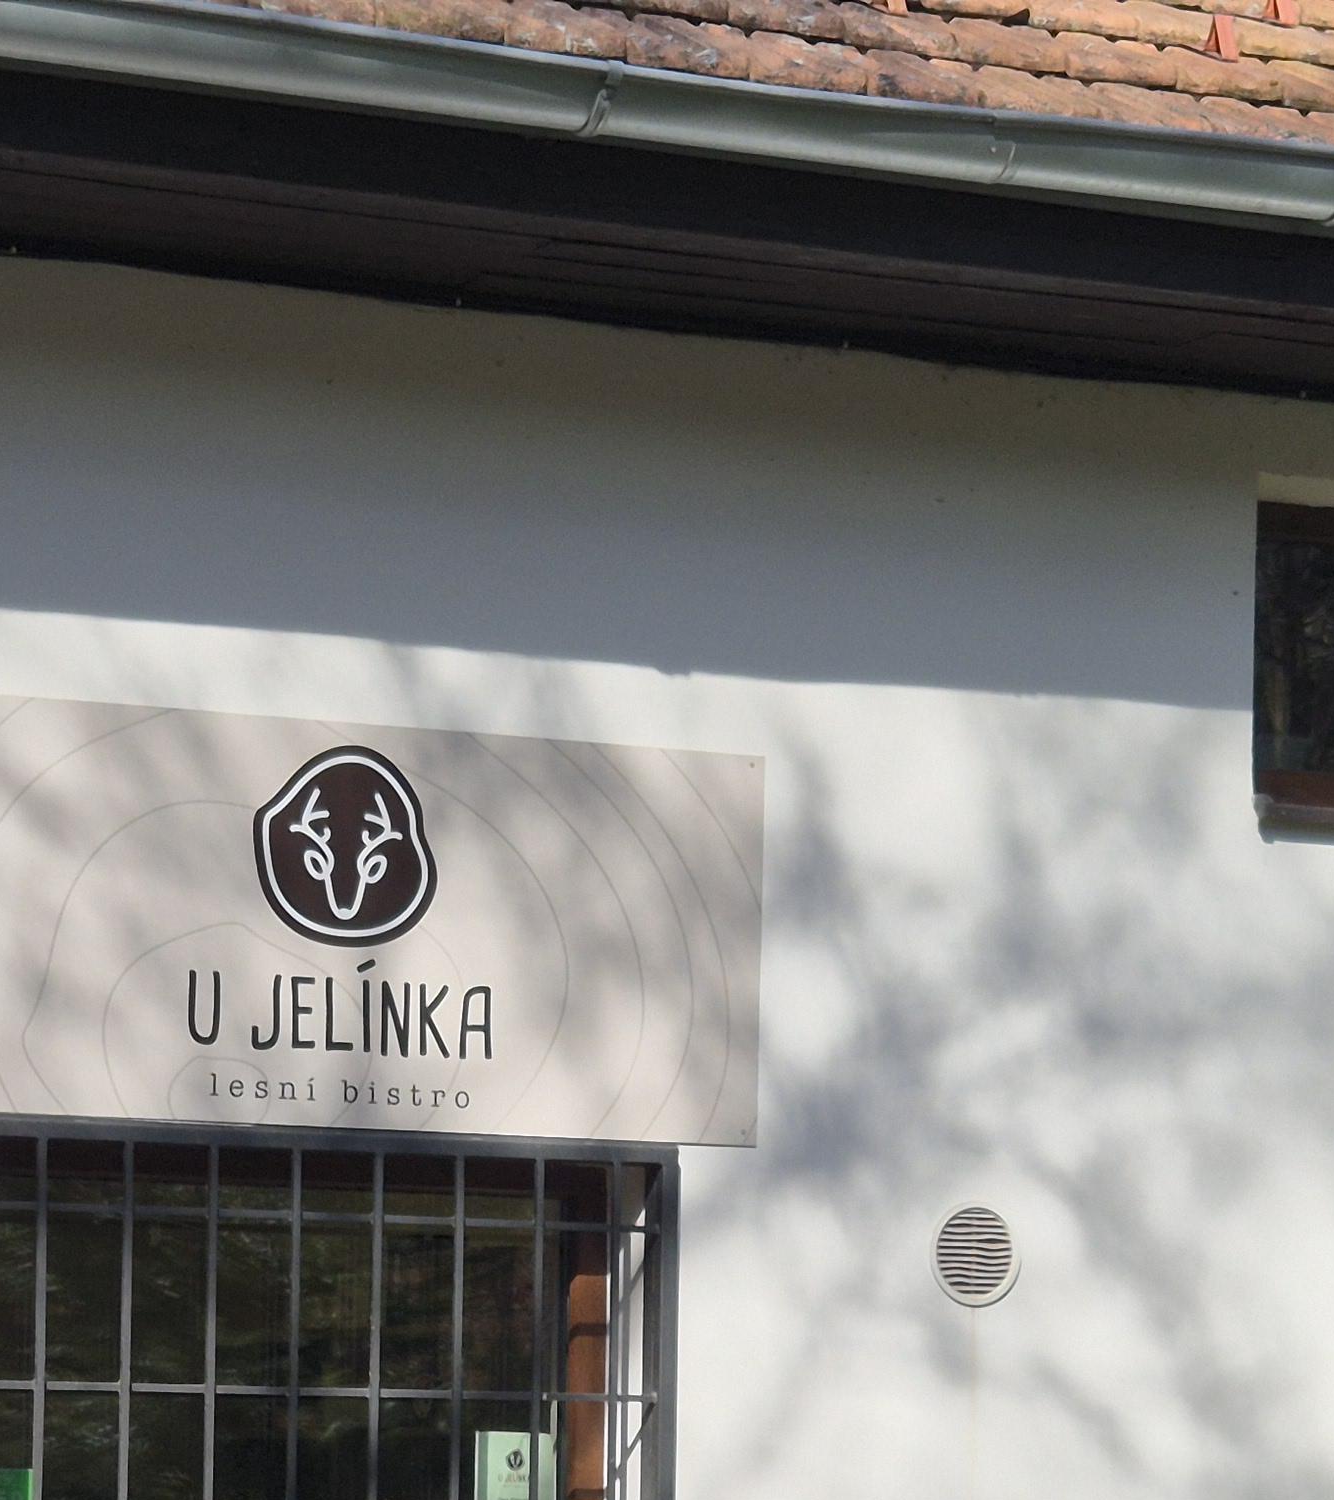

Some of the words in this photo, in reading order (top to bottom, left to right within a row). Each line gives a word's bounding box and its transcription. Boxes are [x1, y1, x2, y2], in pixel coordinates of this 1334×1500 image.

[188, 969, 221, 1045] U
[251, 958, 493, 1060] JELÍNKA
[209, 1073, 316, 1101] lesní
[341, 1079, 471, 1109] bistro
